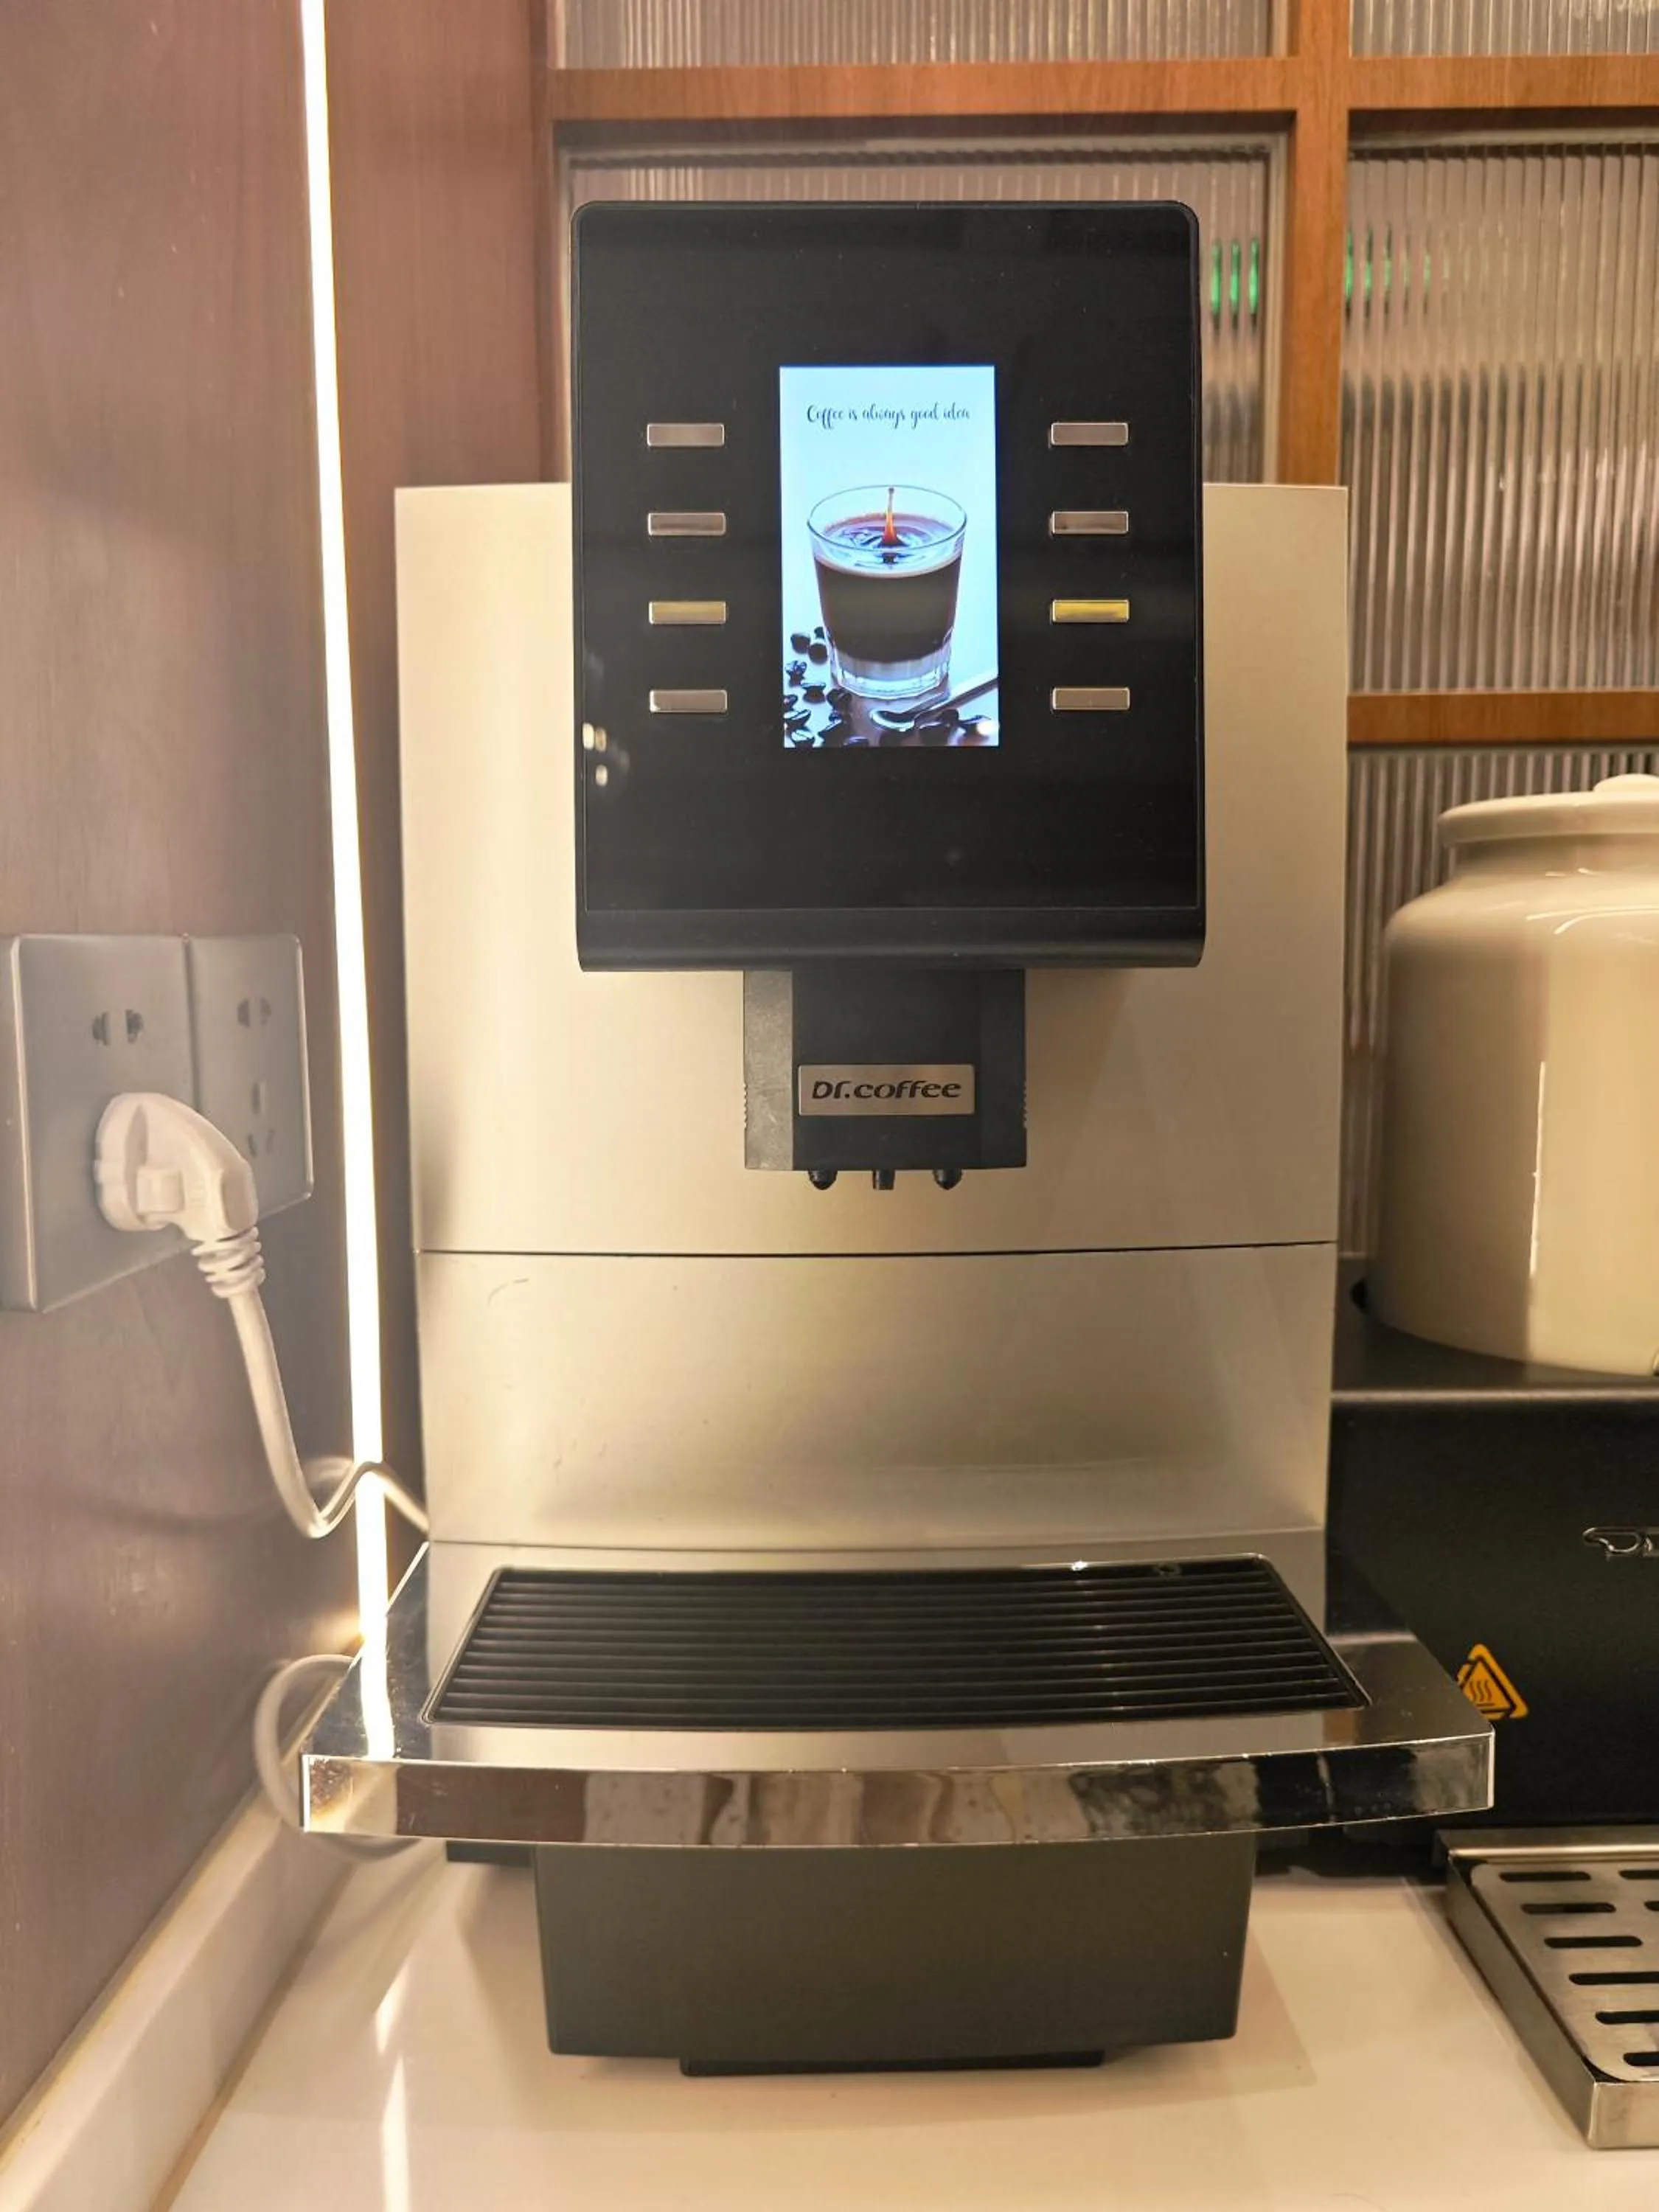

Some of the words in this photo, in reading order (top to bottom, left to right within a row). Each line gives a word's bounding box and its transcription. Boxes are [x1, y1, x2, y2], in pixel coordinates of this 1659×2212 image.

[807, 405, 844, 429] Coffee
[849, 407, 858, 421] is
[862, 403, 905, 429] always
[911, 402, 939, 429] good
[944, 402, 970, 420] idea
[812, 1080, 961, 1099] Dr.coffee
